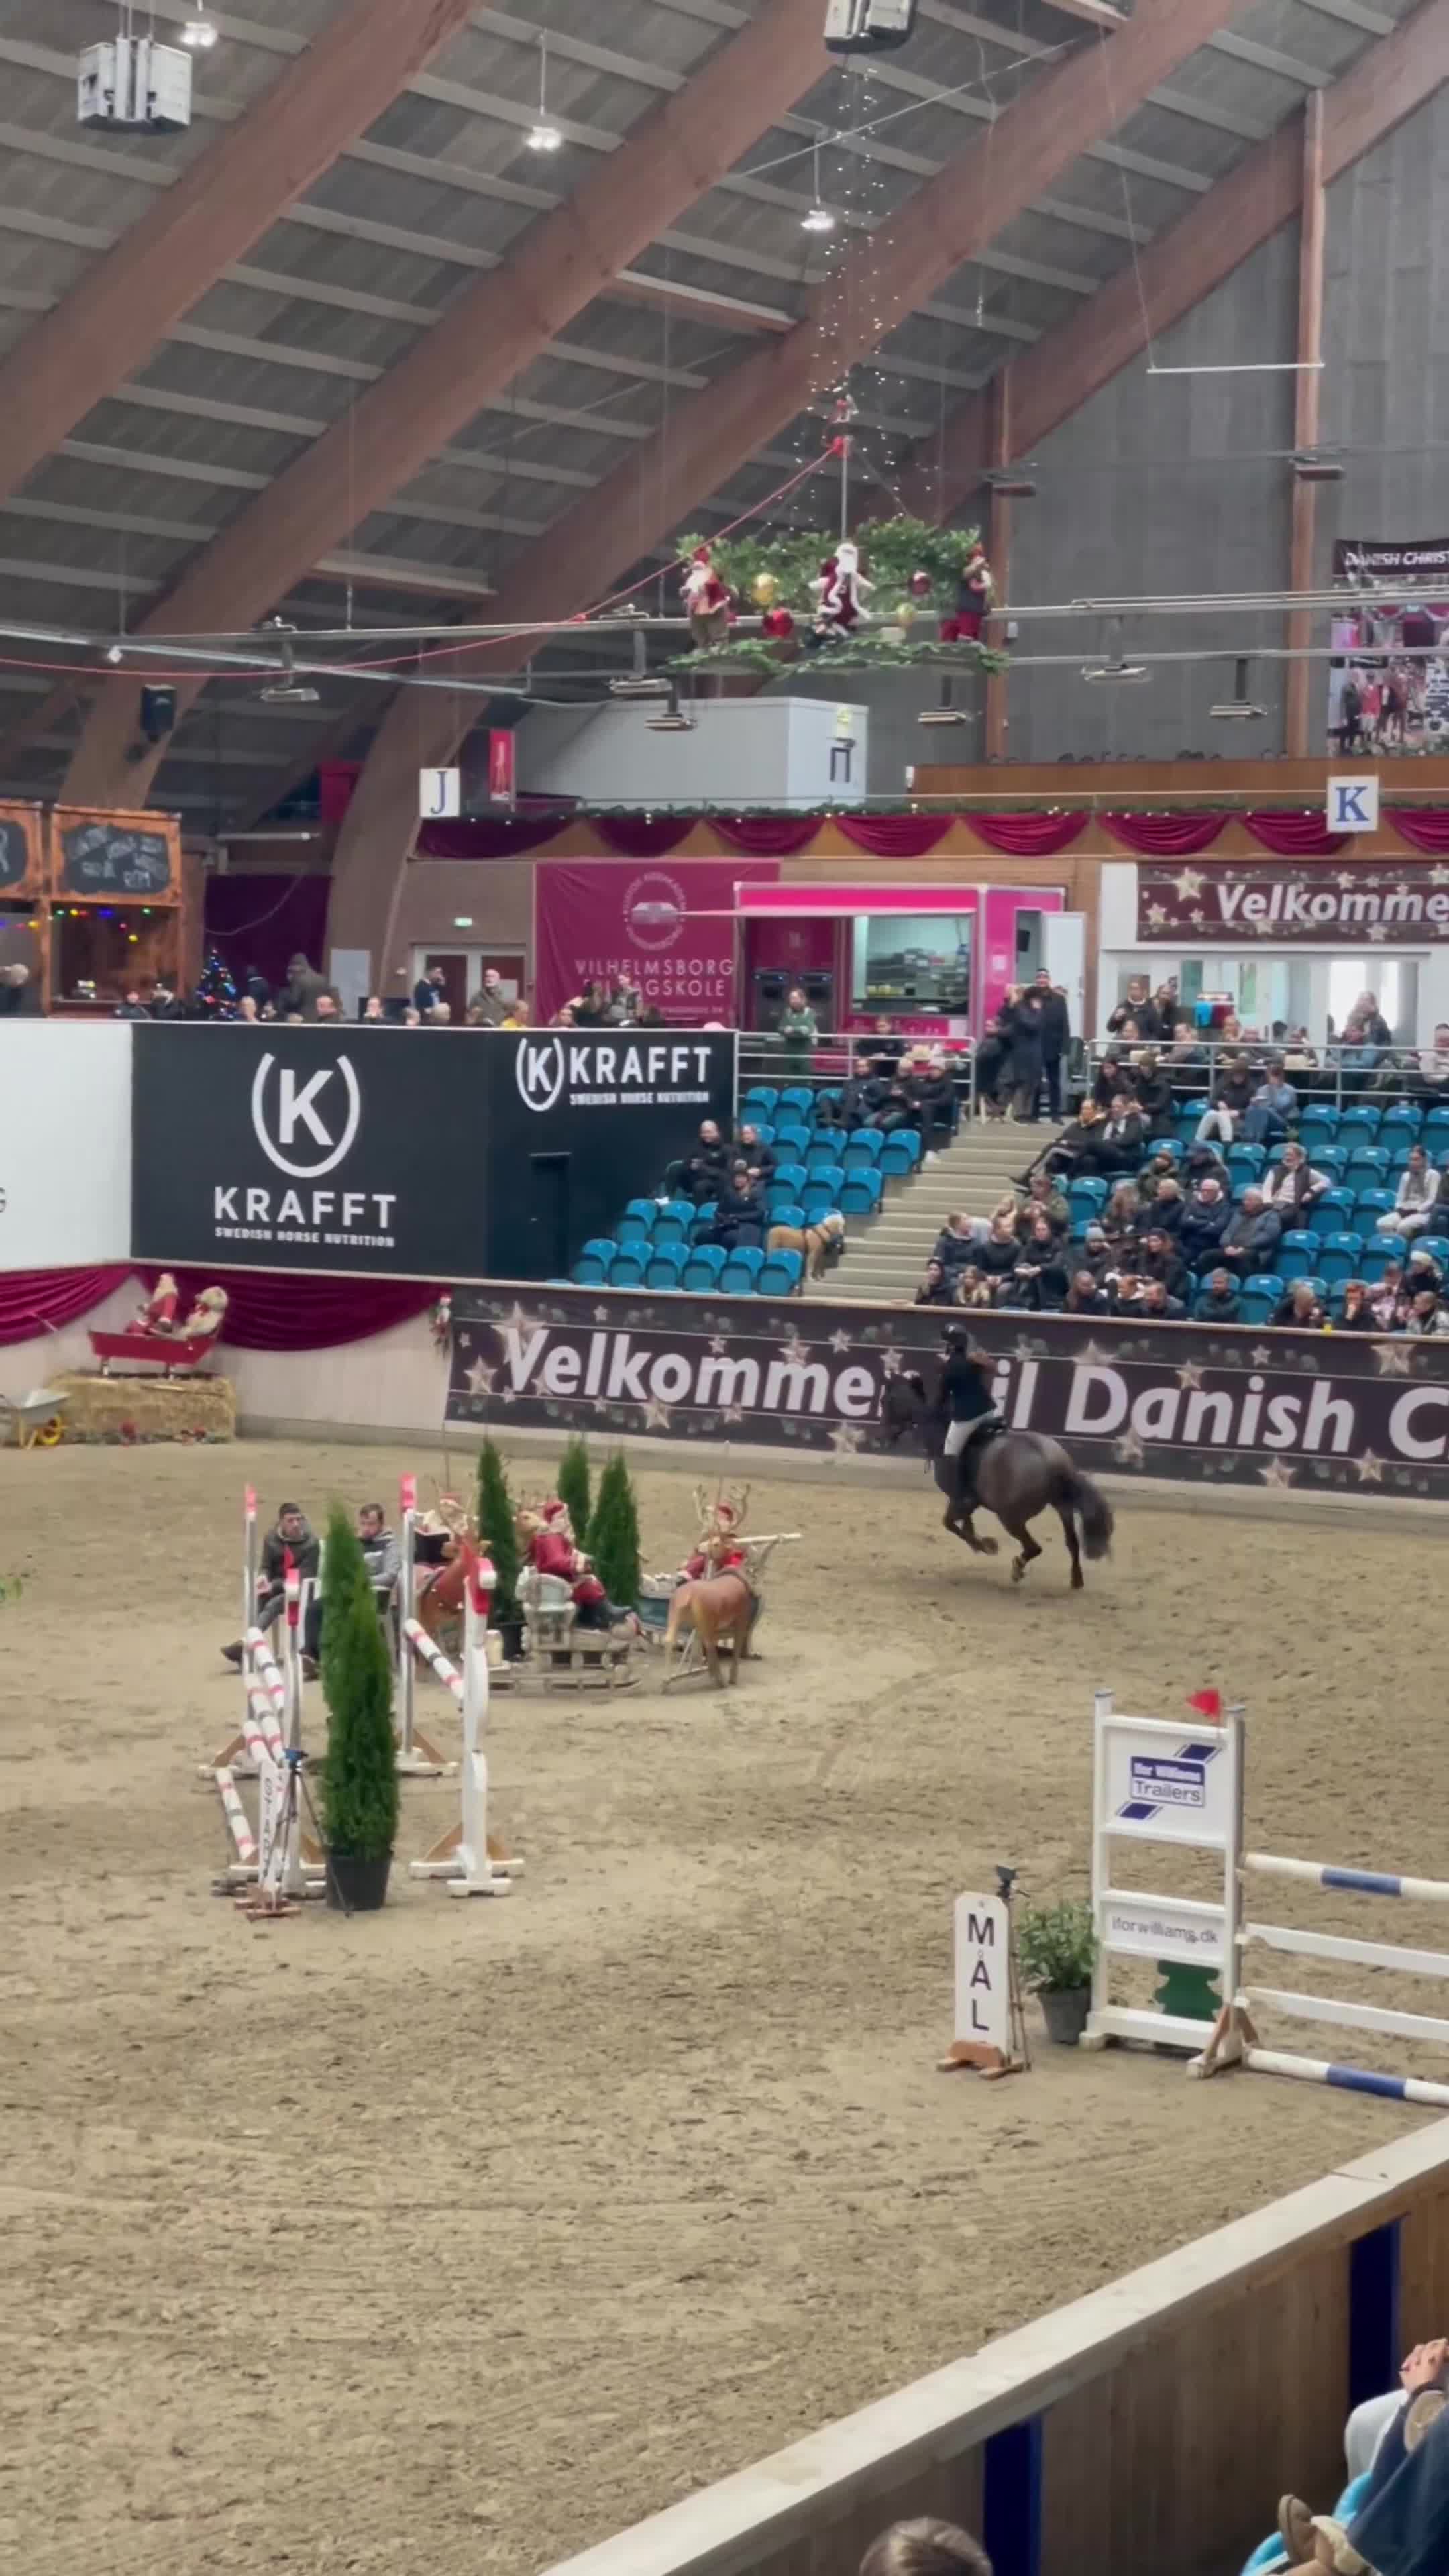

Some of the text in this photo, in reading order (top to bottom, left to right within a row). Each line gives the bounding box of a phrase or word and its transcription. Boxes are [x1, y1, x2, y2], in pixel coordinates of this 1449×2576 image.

[430, 771, 448, 814] J
[1336, 786, 1371, 822] K
[575, 959, 733, 975] VILHELMSBORG
[633, 979, 725, 996] AGSKOLE
[570, 1046, 711, 1084] KRAFFT
[215, 1185, 396, 1229] KRAFFT
[215, 1226, 395, 1248] SWEDISH HORSE NUTRITION
[507, 1328, 1449, 1459] Velkomme il Danish C
[1134, 1780, 1201, 1802] Trailers
[967, 1913, 995, 2031] MÅL
